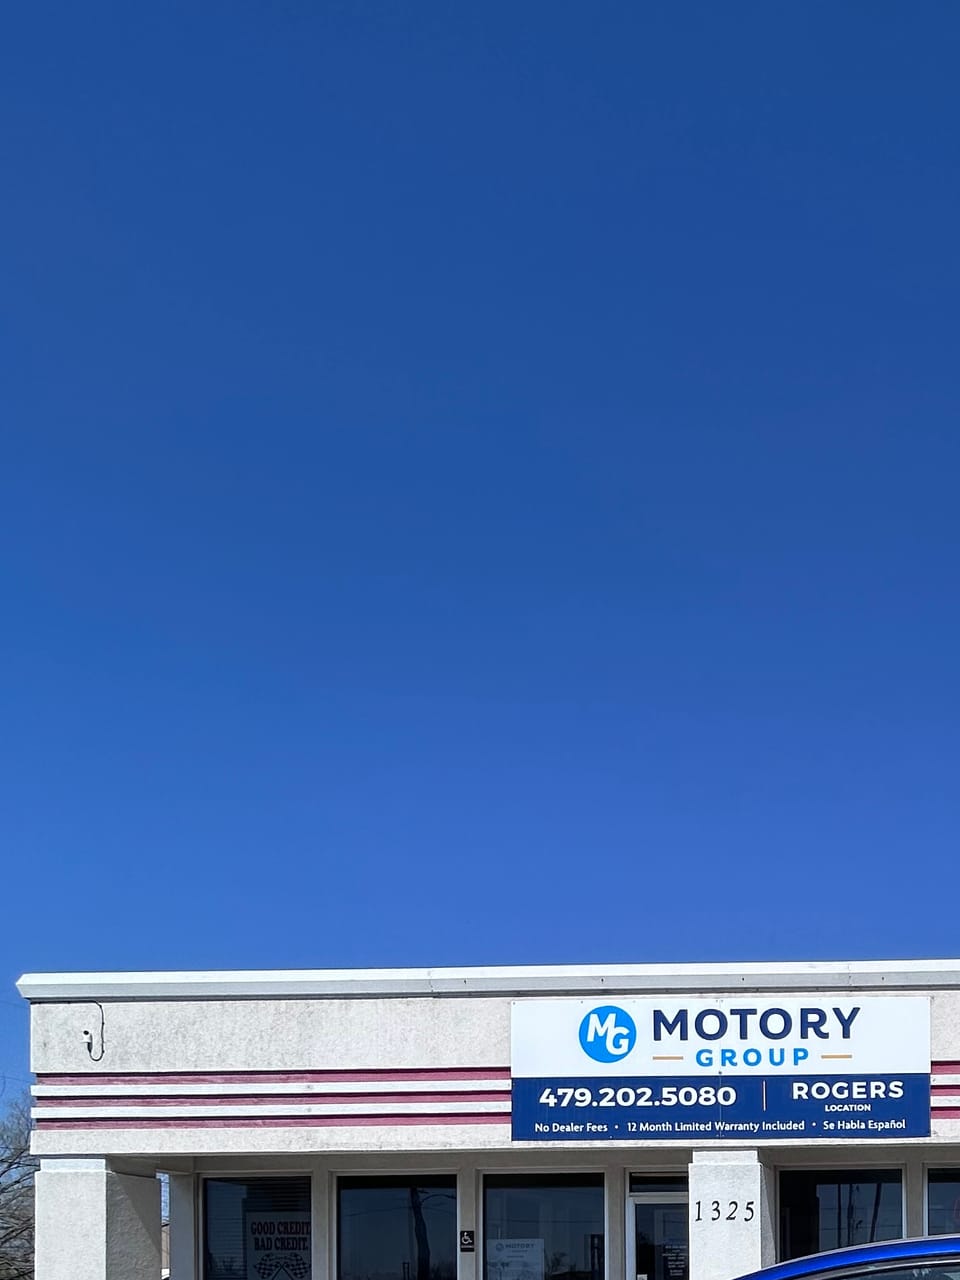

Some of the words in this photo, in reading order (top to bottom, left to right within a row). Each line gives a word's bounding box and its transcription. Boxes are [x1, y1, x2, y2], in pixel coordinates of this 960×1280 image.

[653, 1007, 860, 1041] MOTORY
[586, 1013, 630, 1055] MG
[695, 1048, 810, 1067] GROUP
[539, 1086, 736, 1107] 479.202.5080
[792, 1081, 903, 1100] ROGERS
[825, 1104, 871, 1112] LOCATION
[535, 1122, 549, 1132] No
[552, 1122, 584, 1132] Dealer
[586, 1122, 607, 1132] Fees
[628, 1122, 637, 1132] 12
[640, 1121, 672, 1132] Month
[675, 1121, 711, 1131] Limited
[714, 1121, 760, 1135] Warranty
[763, 1120, 804, 1131] Included
[823, 1121, 834, 1130] Se
[838, 1120, 864, 1130] Habla
[868, 1120, 905, 1133] Español
[695, 1201, 754, 1222] 1325
[251, 1221, 275, 1235] GOOD
[254, 1237, 272, 1250] BAD
